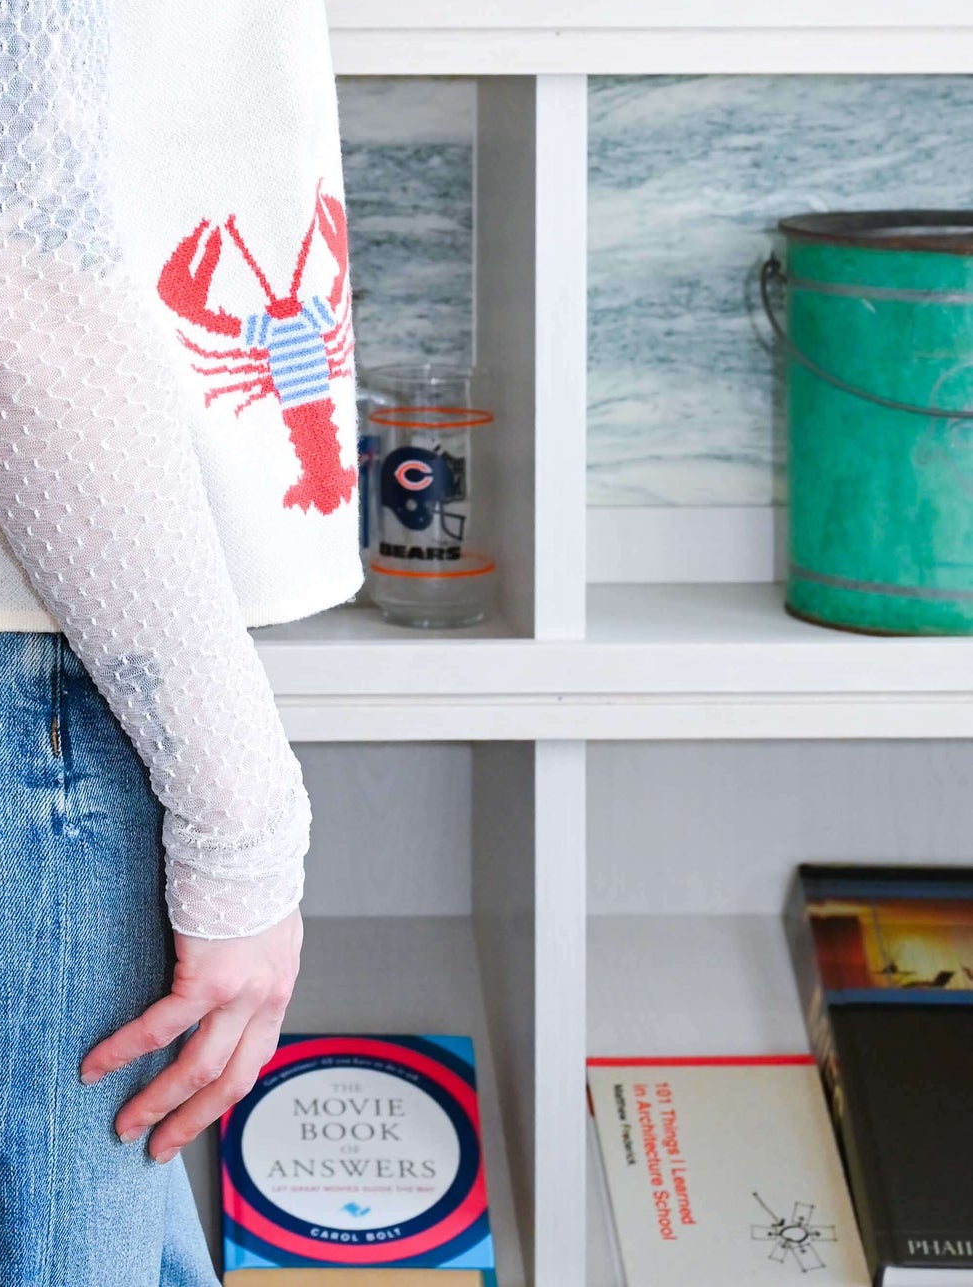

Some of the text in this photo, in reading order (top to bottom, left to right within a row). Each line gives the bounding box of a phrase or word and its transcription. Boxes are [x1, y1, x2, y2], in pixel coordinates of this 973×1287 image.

[379, 542, 461, 560] BEARS
[332, 1083, 361, 1093] THE
[655, 1082, 672, 1103] 101
[293, 1098, 405, 1117] MOVIE
[301, 1122, 401, 1141] BOOK
[660, 1110, 680, 1155] Things
[340, 1145, 360, 1154] OF
[267, 1159, 436, 1179] ANSWERS
[633, 1084, 678, 1240] in Architecture School
[671, 1167, 696, 1225] Learned
[310, 1228, 402, 1242] CAROL BOLT
